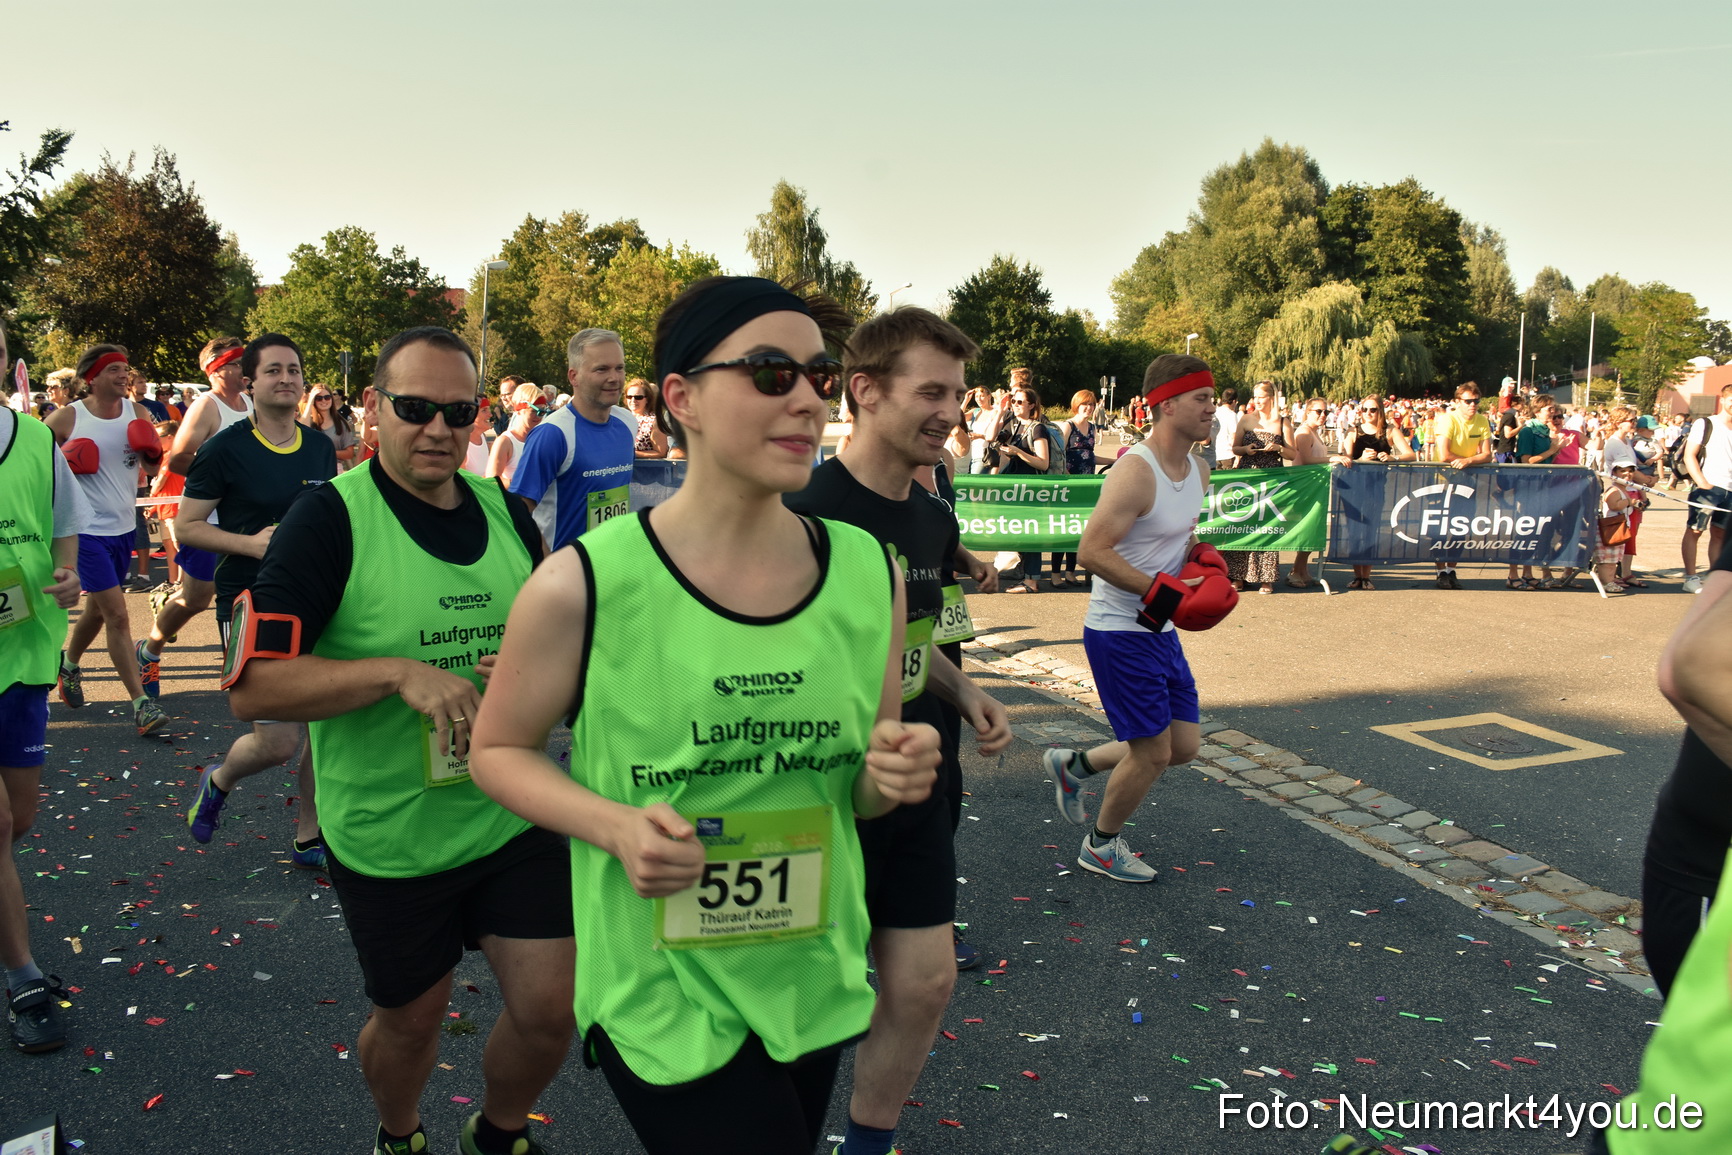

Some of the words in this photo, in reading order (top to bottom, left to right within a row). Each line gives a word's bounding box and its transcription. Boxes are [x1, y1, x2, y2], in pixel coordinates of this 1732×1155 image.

[955, 483, 1071, 502] sundheit
[594, 501, 627, 524] 1806
[1420, 509, 1552, 536] Fischer
[1429, 540, 1539, 551] AUTOMOBILE
[454, 603, 487, 611] sports
[421, 651, 473, 670] zamt
[691, 717, 841, 746] Laufgruppe
[697, 857, 790, 910] 551
[754, 906, 793, 921] Katrin
